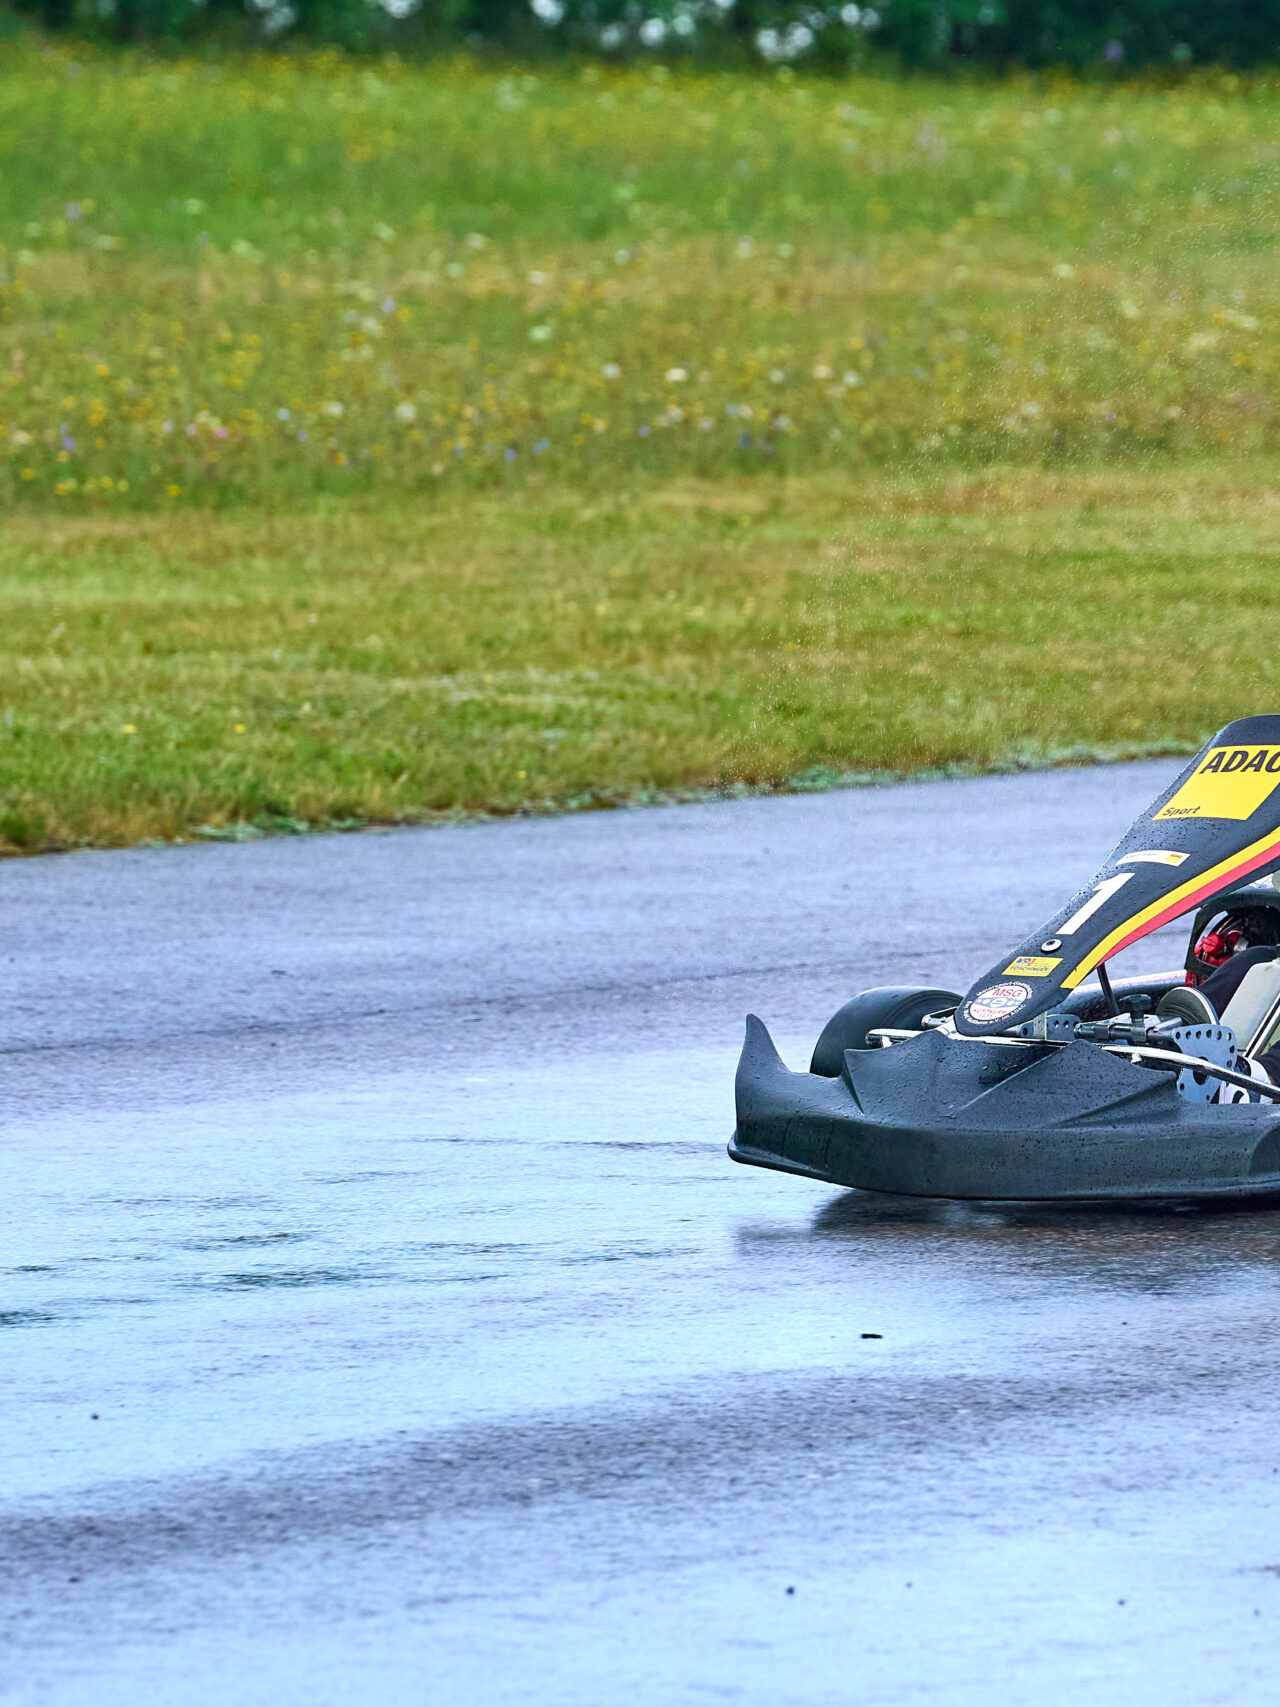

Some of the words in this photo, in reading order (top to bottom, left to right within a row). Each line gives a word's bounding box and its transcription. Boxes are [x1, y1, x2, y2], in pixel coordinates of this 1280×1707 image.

[1161, 806, 1201, 817] Sport
[1055, 872, 1135, 936] 1
[992, 988, 1023, 997] MSG
